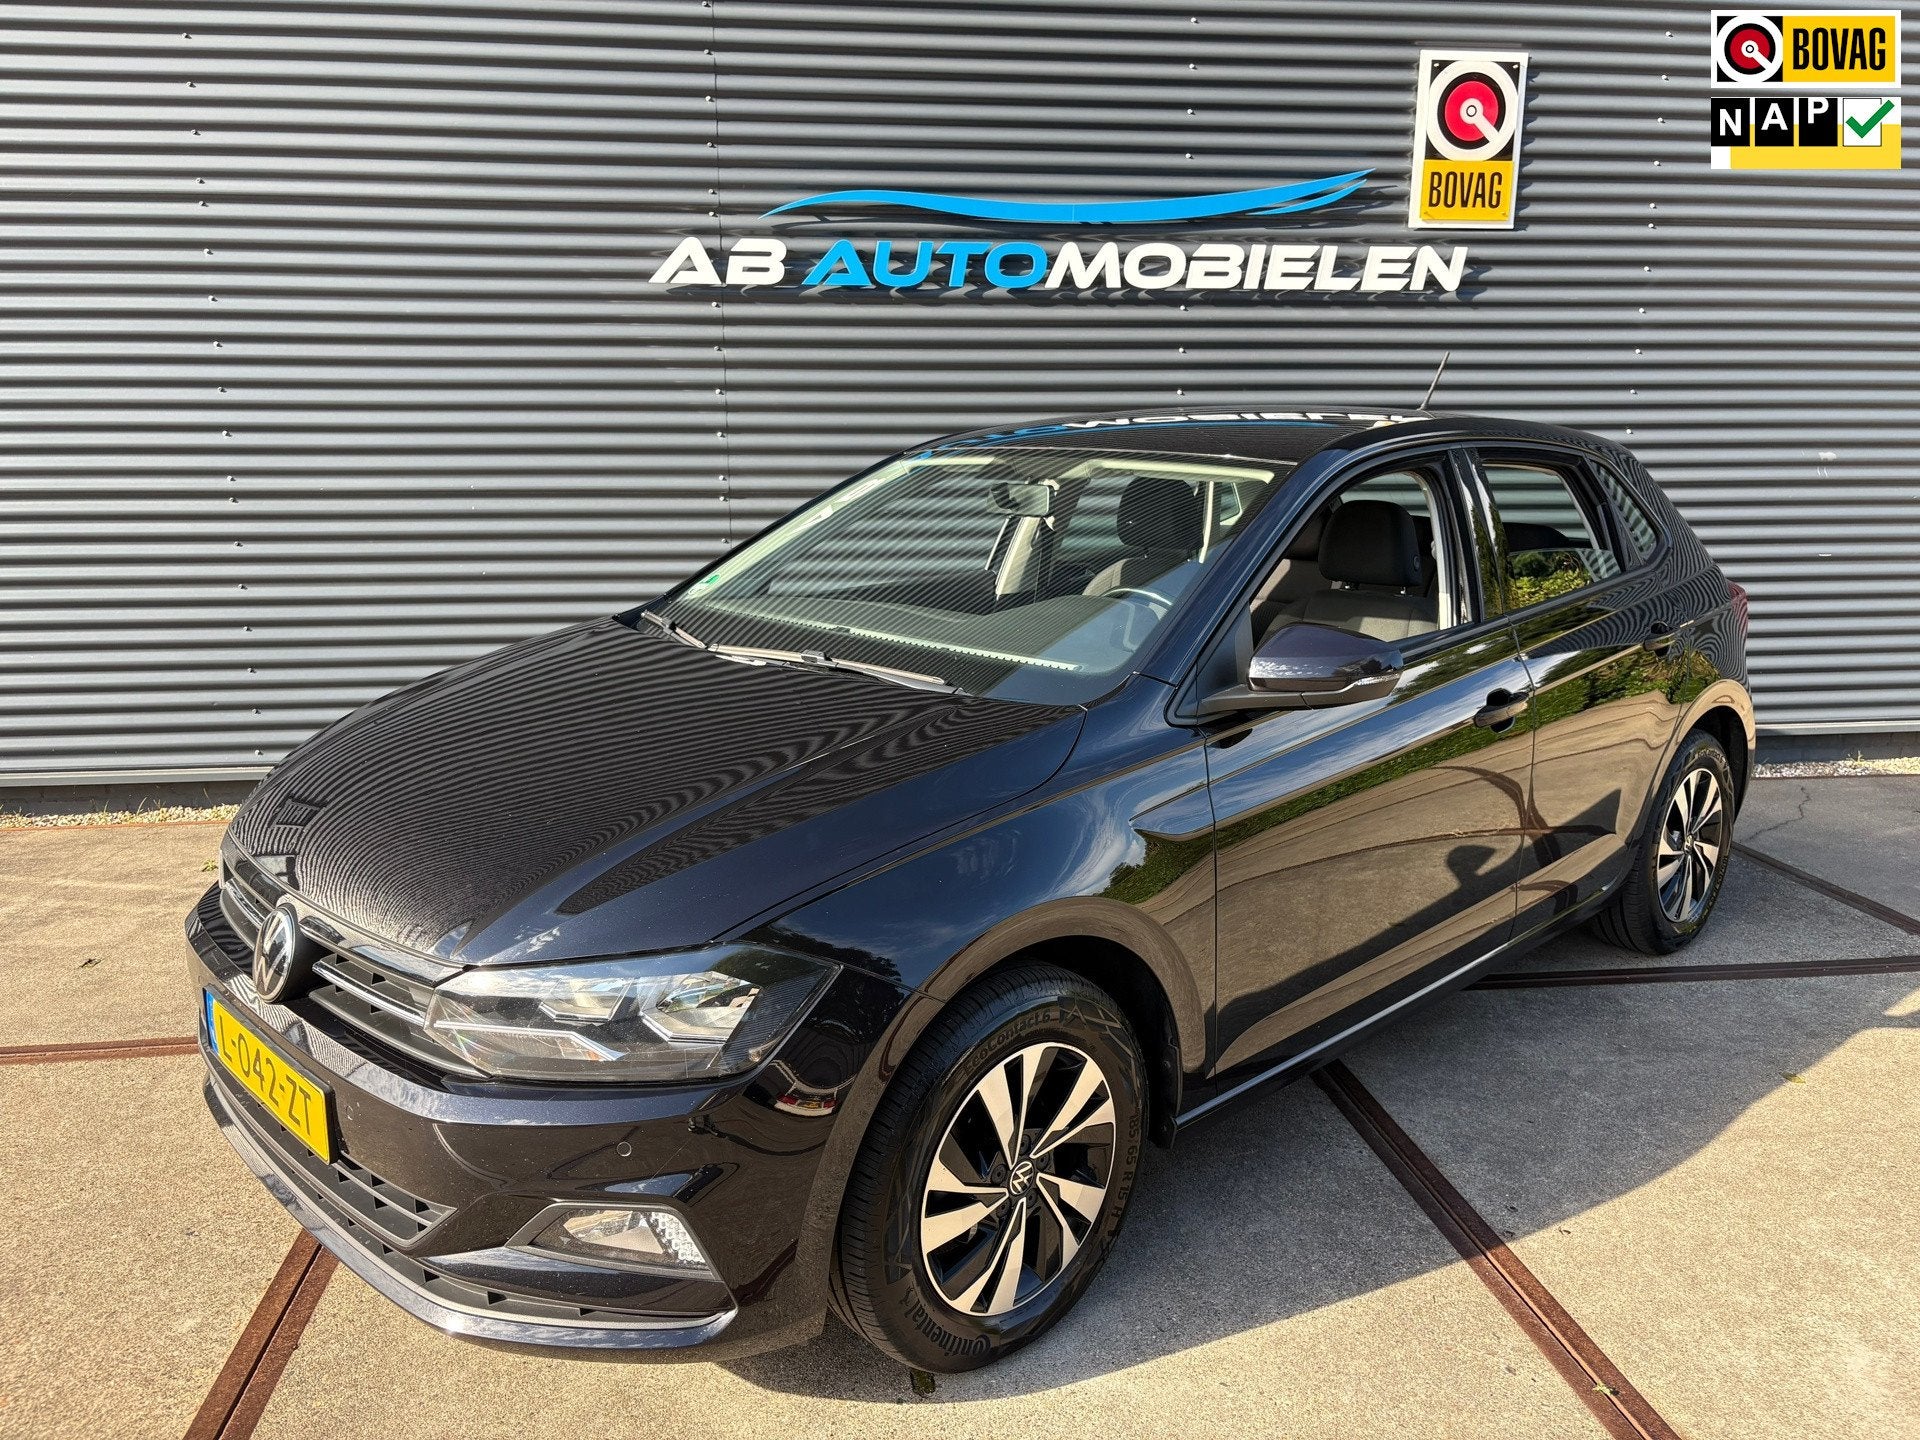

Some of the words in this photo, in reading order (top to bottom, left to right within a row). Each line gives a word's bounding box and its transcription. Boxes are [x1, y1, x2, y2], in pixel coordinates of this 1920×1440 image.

[1428, 170, 1503, 210] BOVAG
[649, 237, 787, 286] AB
[801, 239, 1468, 292] AUTOMOBIELEN
[218, 1013, 312, 1137] L-042-ZT
[903, 1298, 992, 1358] Continental
